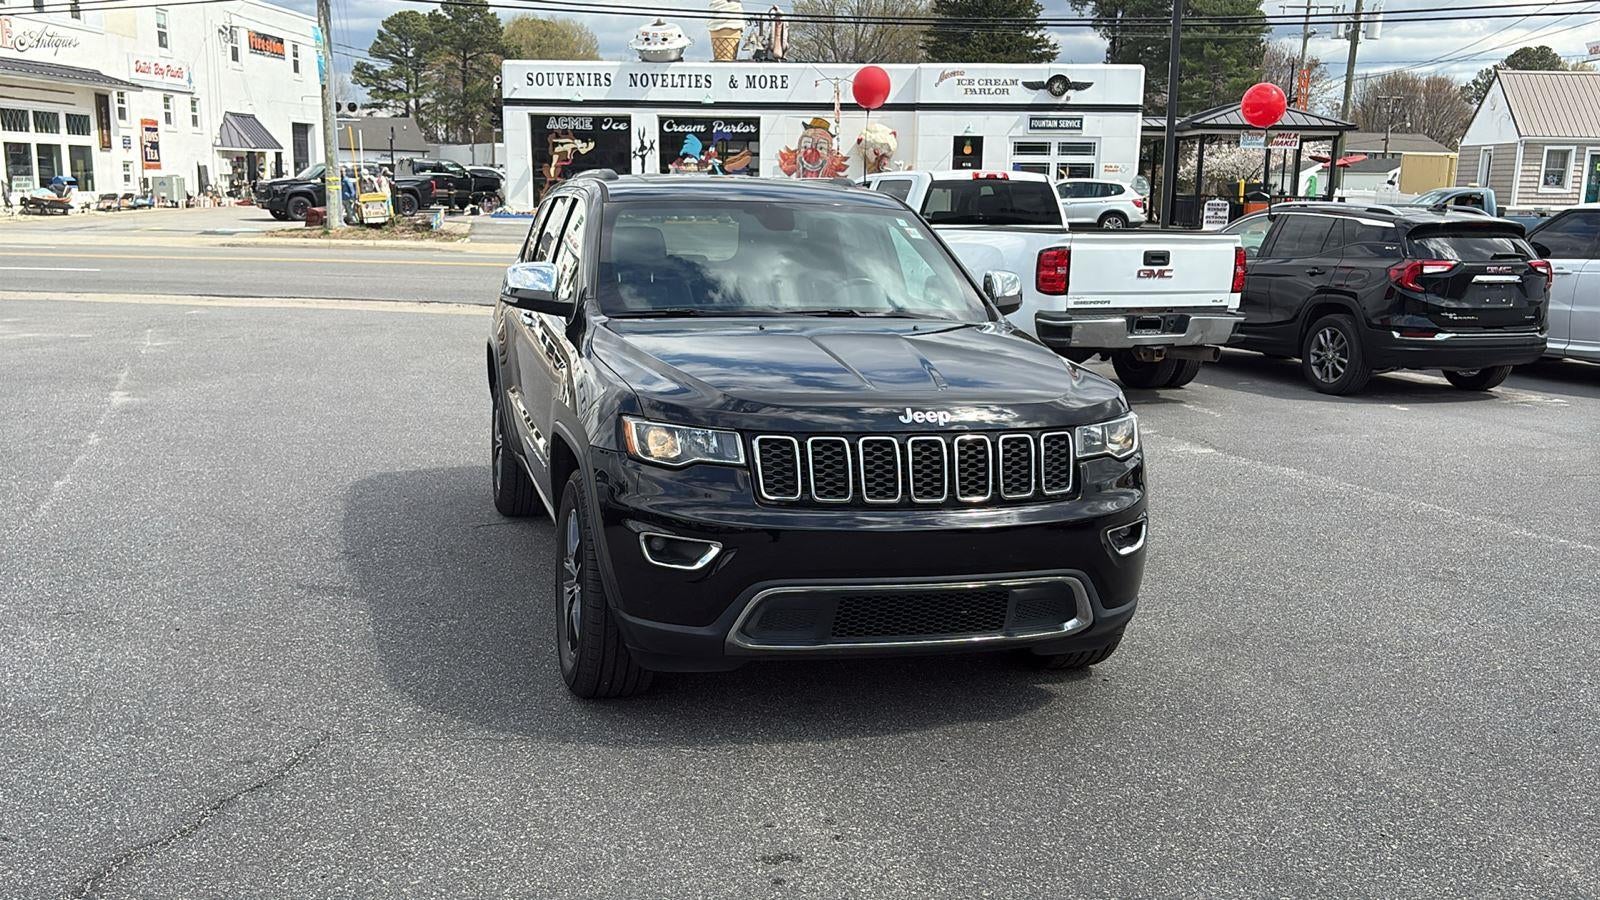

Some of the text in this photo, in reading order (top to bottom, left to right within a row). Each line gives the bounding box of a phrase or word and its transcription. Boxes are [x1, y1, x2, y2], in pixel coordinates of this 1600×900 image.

[15, 25, 80, 56] Antiques
[249, 30, 285, 55] Firestone
[135, 60, 184, 79] Dutch Boy Paints
[526, 72, 789, 89] SOUVENIRS NOVELTIES & MORE
[956, 78, 975, 86] ICE
[963, 87, 1010, 95] PARLOR
[547, 117, 629, 130] ACME Ice
[663, 119, 758, 133] Cream Parlor
[1031, 119, 1081, 128] FOUNTAIN SERVICE
[1276, 132, 1300, 140] MILK
[1136, 268, 1174, 279] GMC
[899, 407, 951, 426] Jeep
